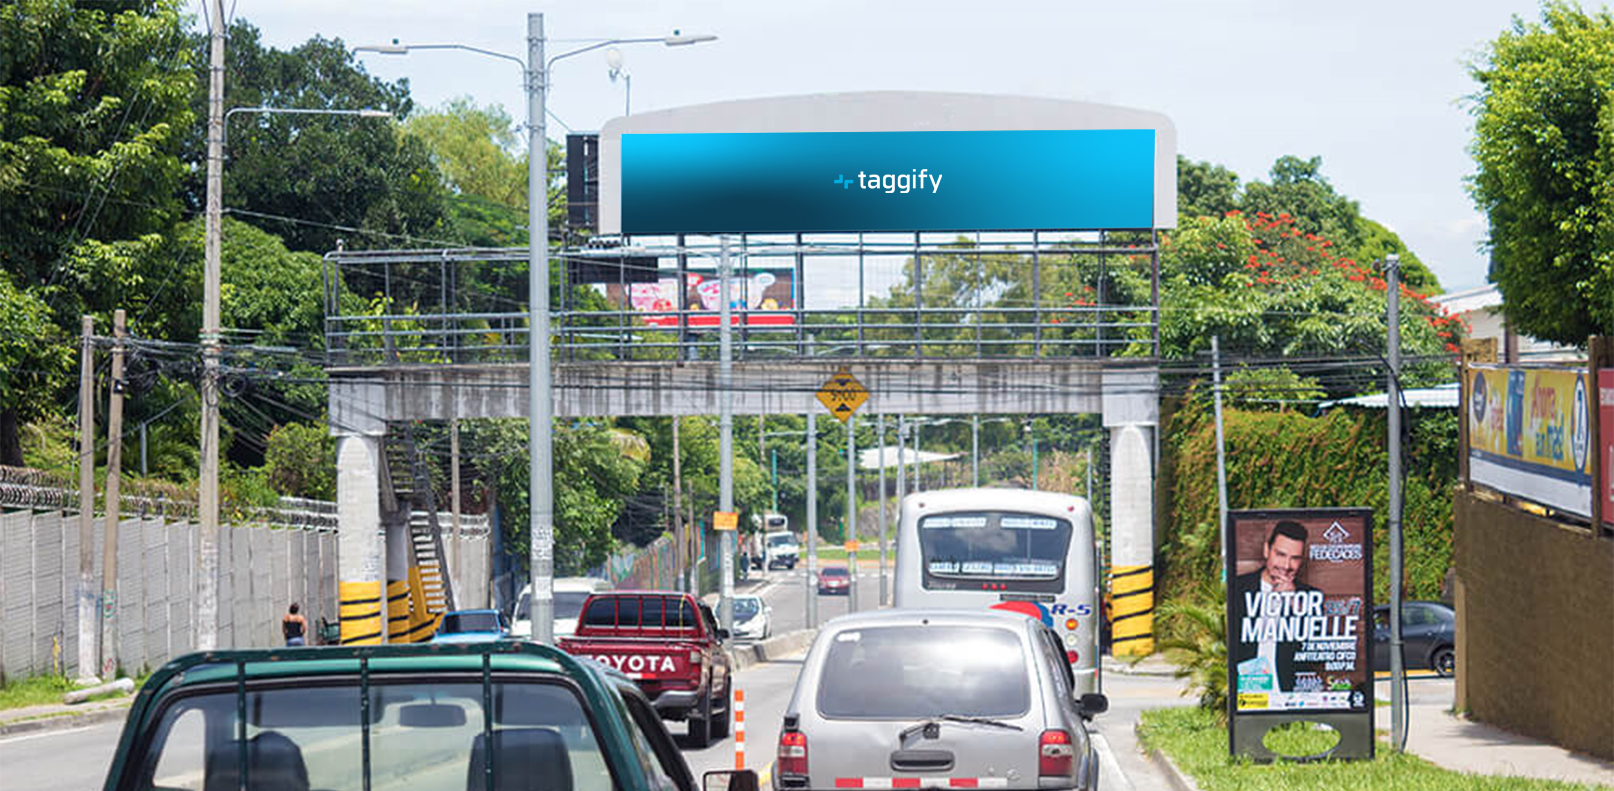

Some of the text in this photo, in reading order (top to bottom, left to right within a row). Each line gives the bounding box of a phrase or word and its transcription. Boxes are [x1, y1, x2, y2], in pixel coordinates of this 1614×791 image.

[858, 169, 942, 193] taggify
[1245, 591, 1323, 617] VICTOR
[1241, 615, 1359, 642] MANUELLE
[1316, 641, 1356, 650] NOVIEMBRE
[588, 655, 676, 672] OYOTA
